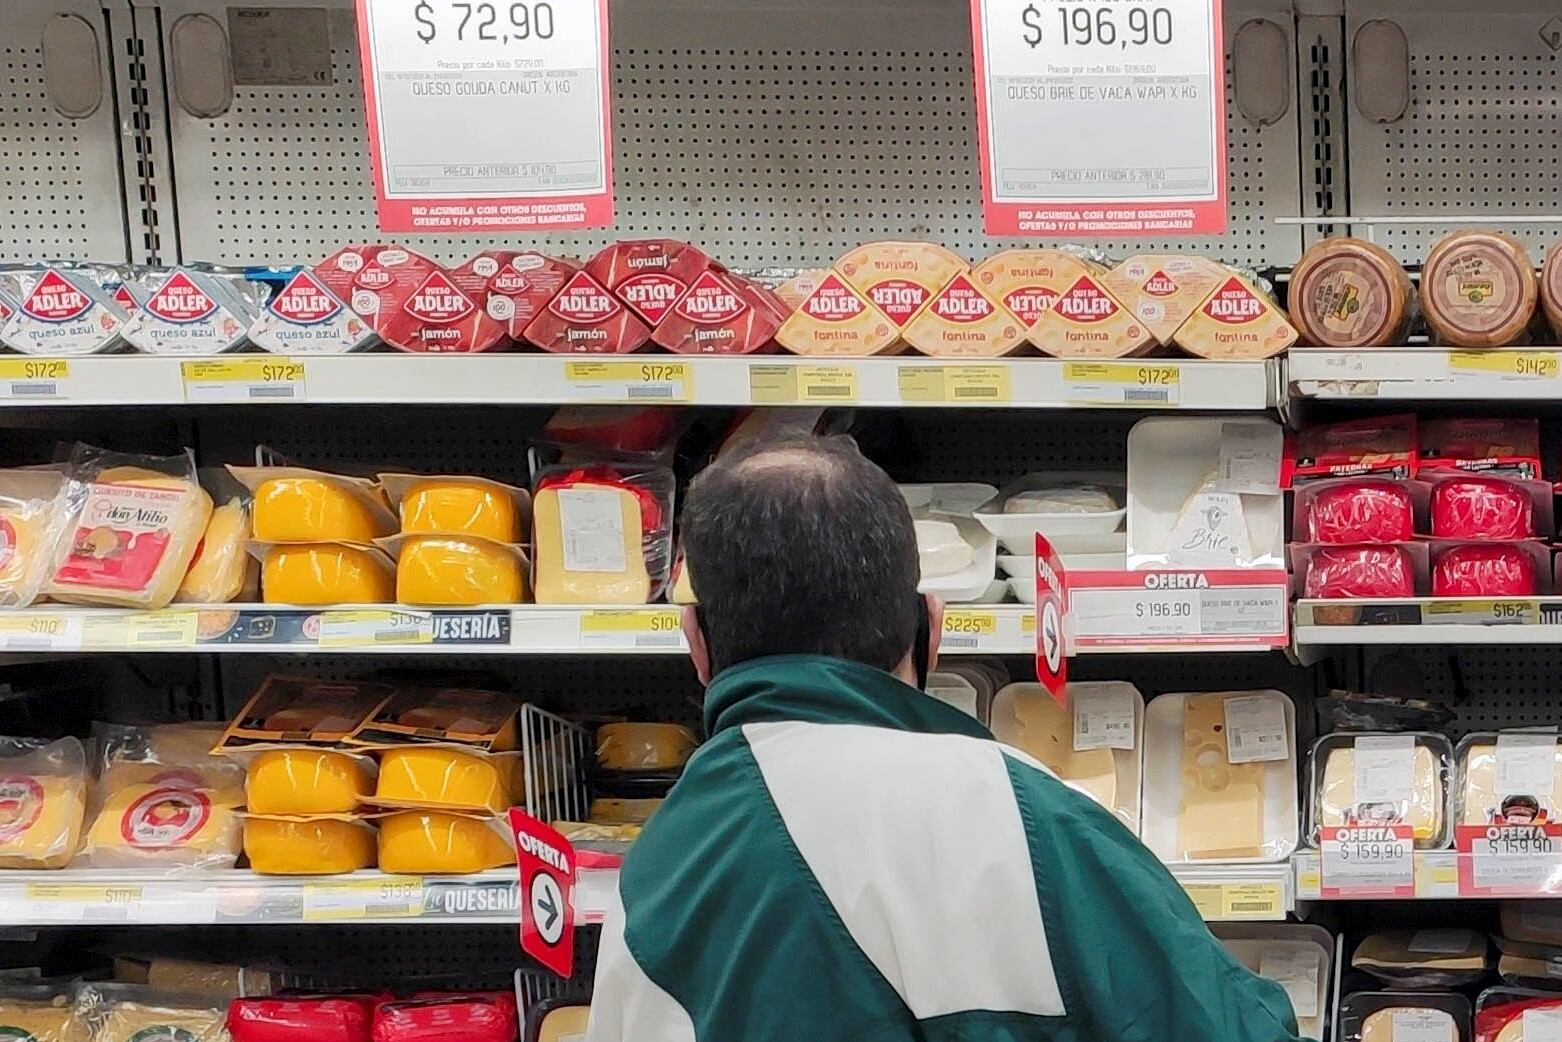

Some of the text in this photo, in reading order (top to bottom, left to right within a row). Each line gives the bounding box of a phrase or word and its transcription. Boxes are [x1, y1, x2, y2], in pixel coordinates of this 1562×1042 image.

[414, 0, 554, 44] $ 72,90
[1022, 3, 1172, 50] $ 196,90
[413, 81, 451, 96] QUESO
[455, 80, 496, 95] GOUDA
[500, 80, 539, 94] CANUT
[555, 79, 571, 94] KG
[1008, 86, 1045, 100] QUESO
[1050, 86, 1074, 99] BRIE
[1079, 86, 1094, 100] DE
[1099, 85, 1132, 99] VACA
[1181, 85, 1197, 99] KG
[32, 296, 82, 314] ADLER
[157, 296, 208, 313] ADLER
[281, 297, 332, 314] ADLER
[415, 296, 464, 312] ADLER
[560, 296, 612, 312] ADLER
[686, 296, 738, 312] ADLER
[809, 297, 863, 314] ADLER
[937, 297, 991, 314] ADLER
[1061, 297, 1113, 314] ADLER
[1210, 299, 1266, 316] ADLER
[29, 326, 96, 341] queso azul
[150, 328, 217, 341] queso azul
[275, 328, 341, 342] queso azul
[566, 327, 608, 341] jamón
[694, 327, 736, 341] jamón
[1144, 573, 1209, 589] OFERTA
[1135, 602, 1144, 618] $
[432, 612, 501, 639] UESERÍA
[1336, 827, 1397, 843] OFERTA
[1486, 826, 1547, 841] OFERTA
[518, 832, 570, 875] OFERTA
[1340, 843, 1349, 860] $
